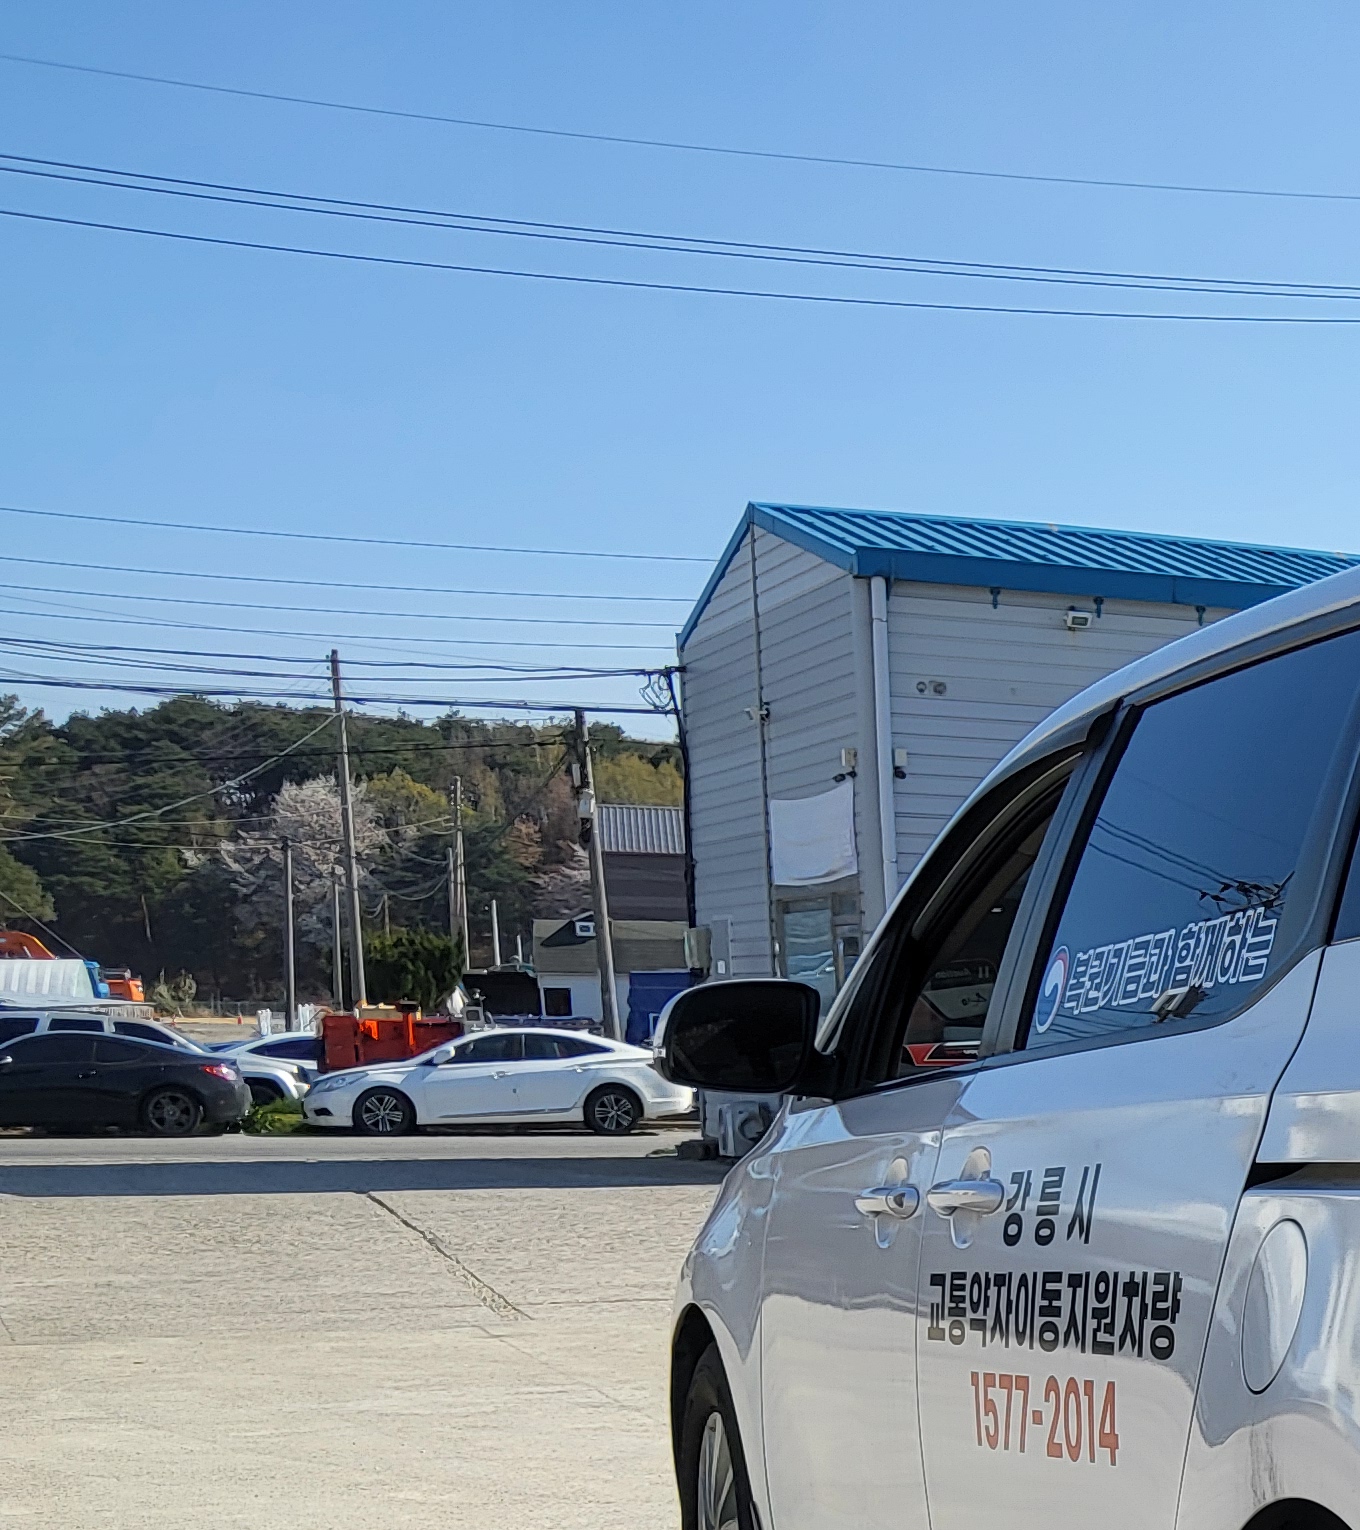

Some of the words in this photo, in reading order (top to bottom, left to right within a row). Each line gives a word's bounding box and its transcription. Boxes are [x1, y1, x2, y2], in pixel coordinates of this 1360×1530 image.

[1002, 1163, 1102, 1246] 강릉시
[926, 1270, 1183, 1360] 교통약자이동지원차량
[971, 1371, 1119, 1467] 1577-2014
